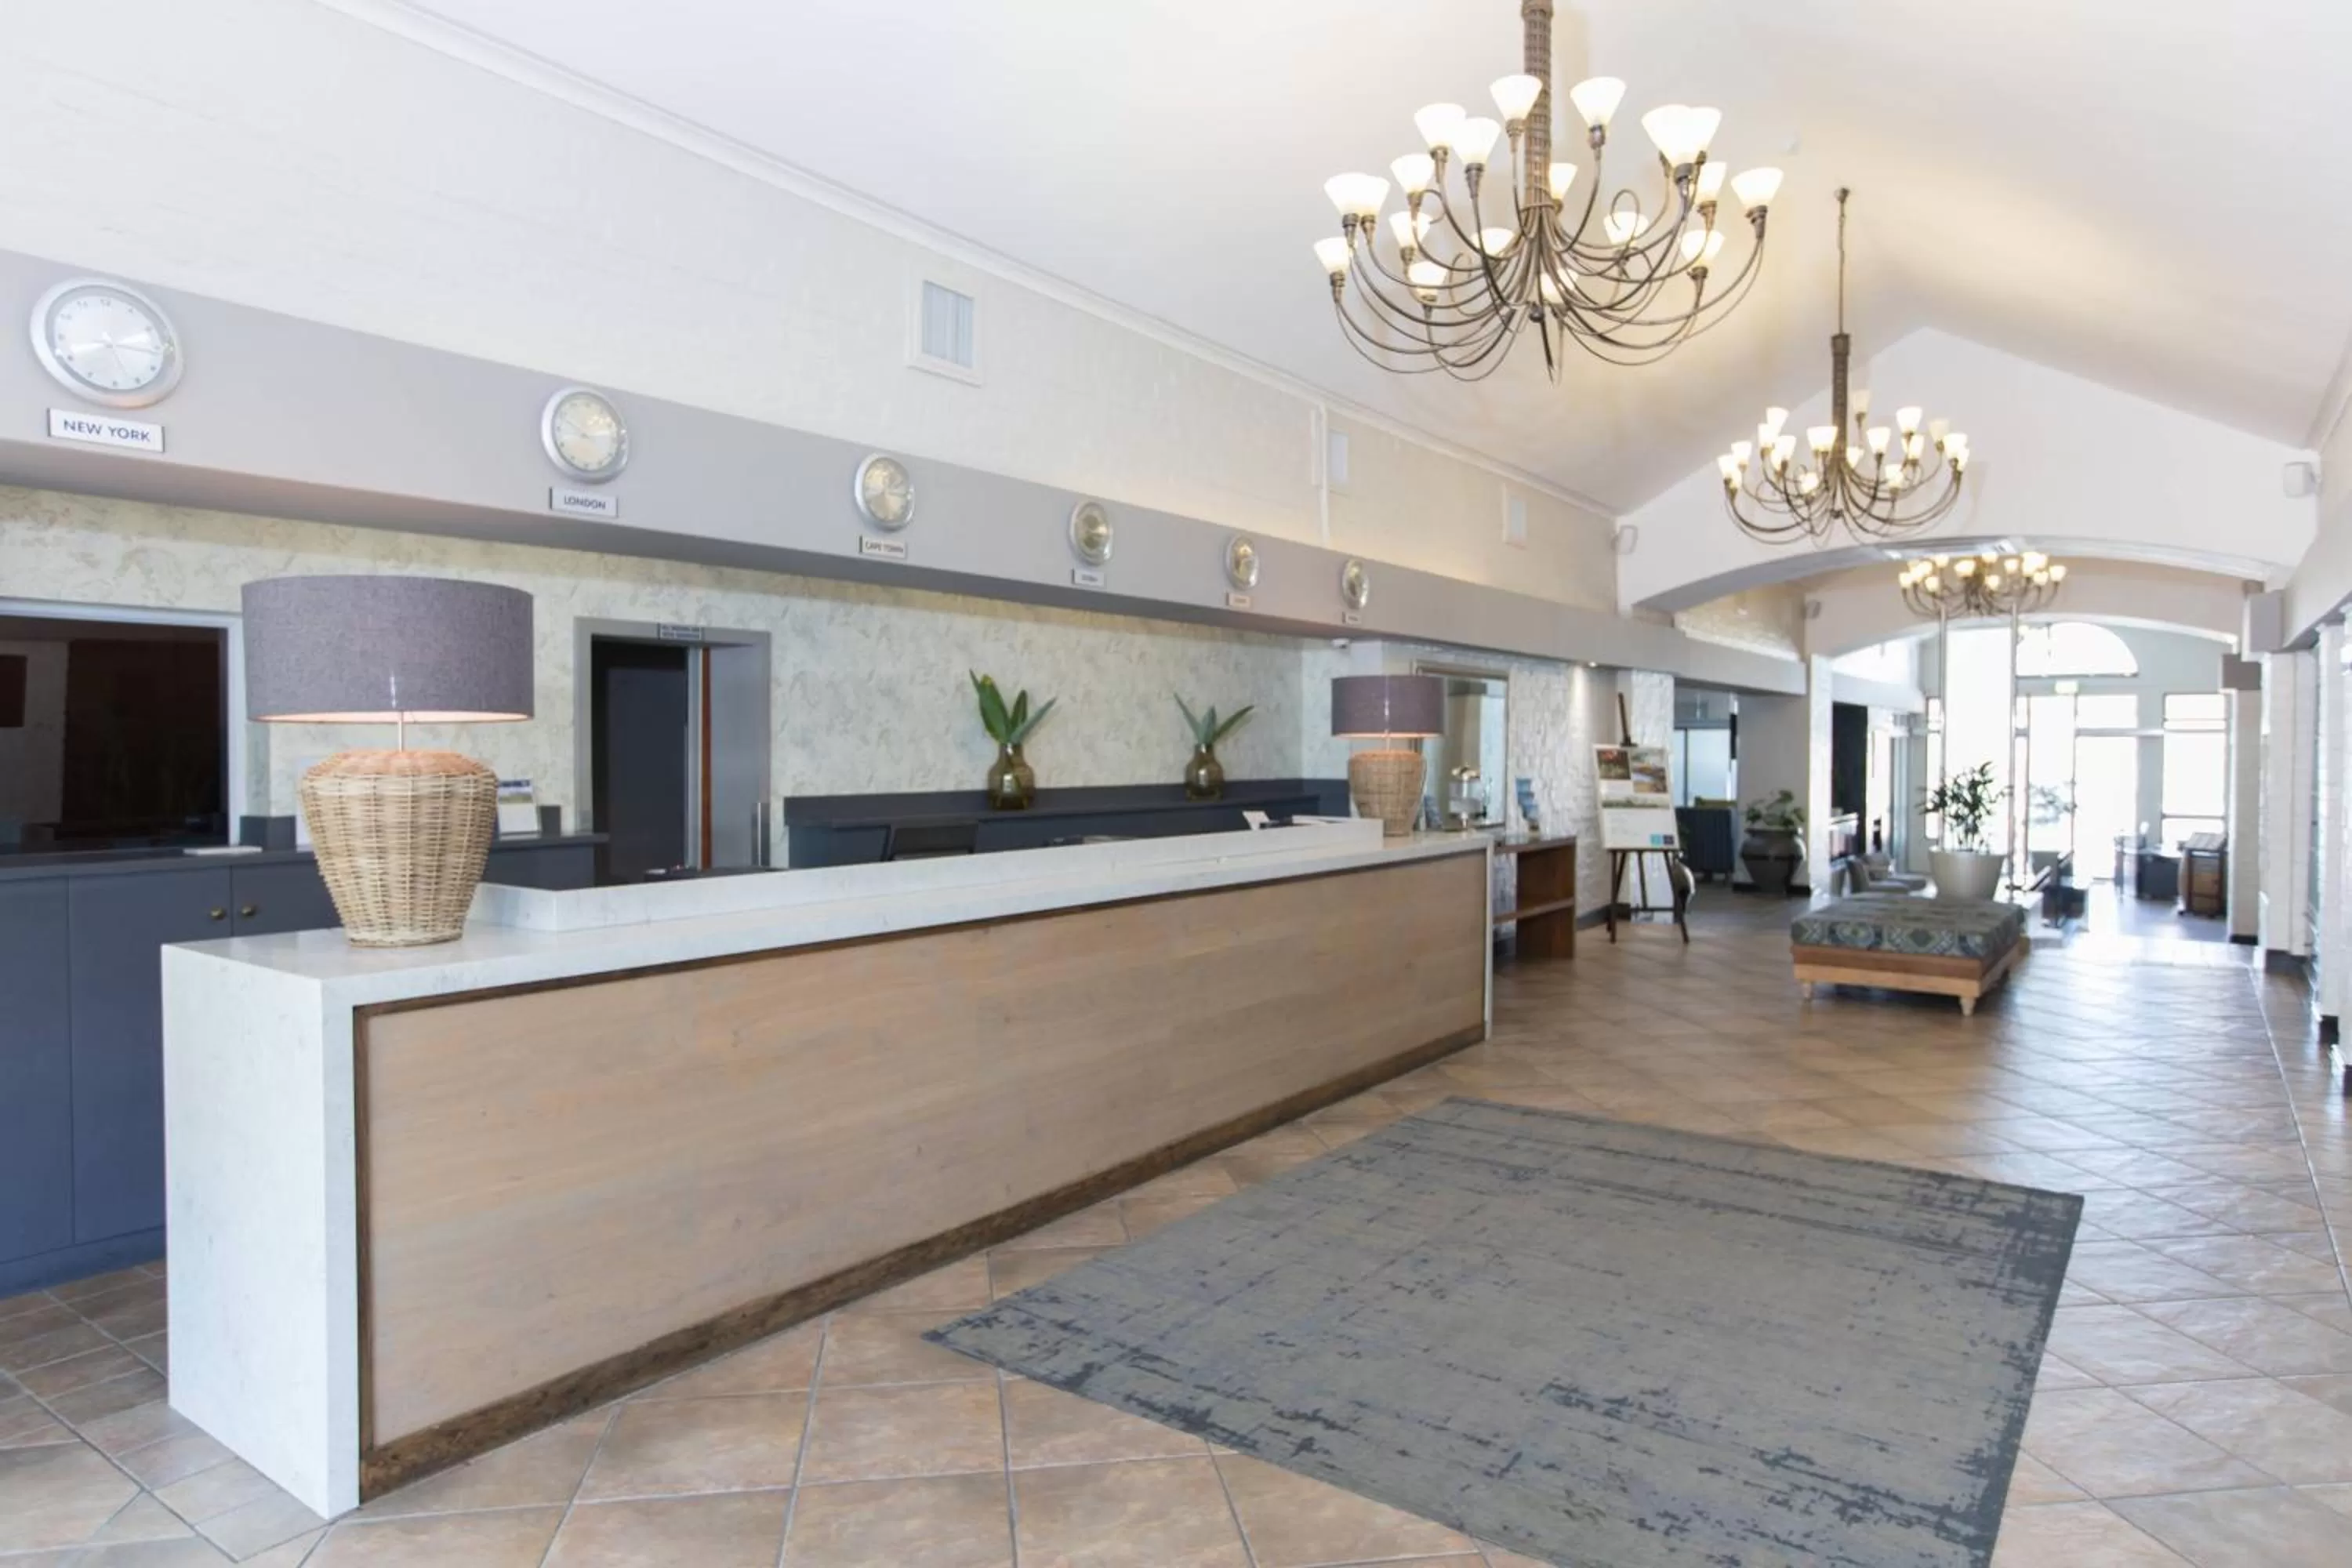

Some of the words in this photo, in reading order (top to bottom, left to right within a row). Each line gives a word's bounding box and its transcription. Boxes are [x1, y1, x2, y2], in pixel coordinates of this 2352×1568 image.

[64, 419, 103, 435] NEW
[107, 426, 151, 442] YORK
[564, 495, 606, 510] LONDON
